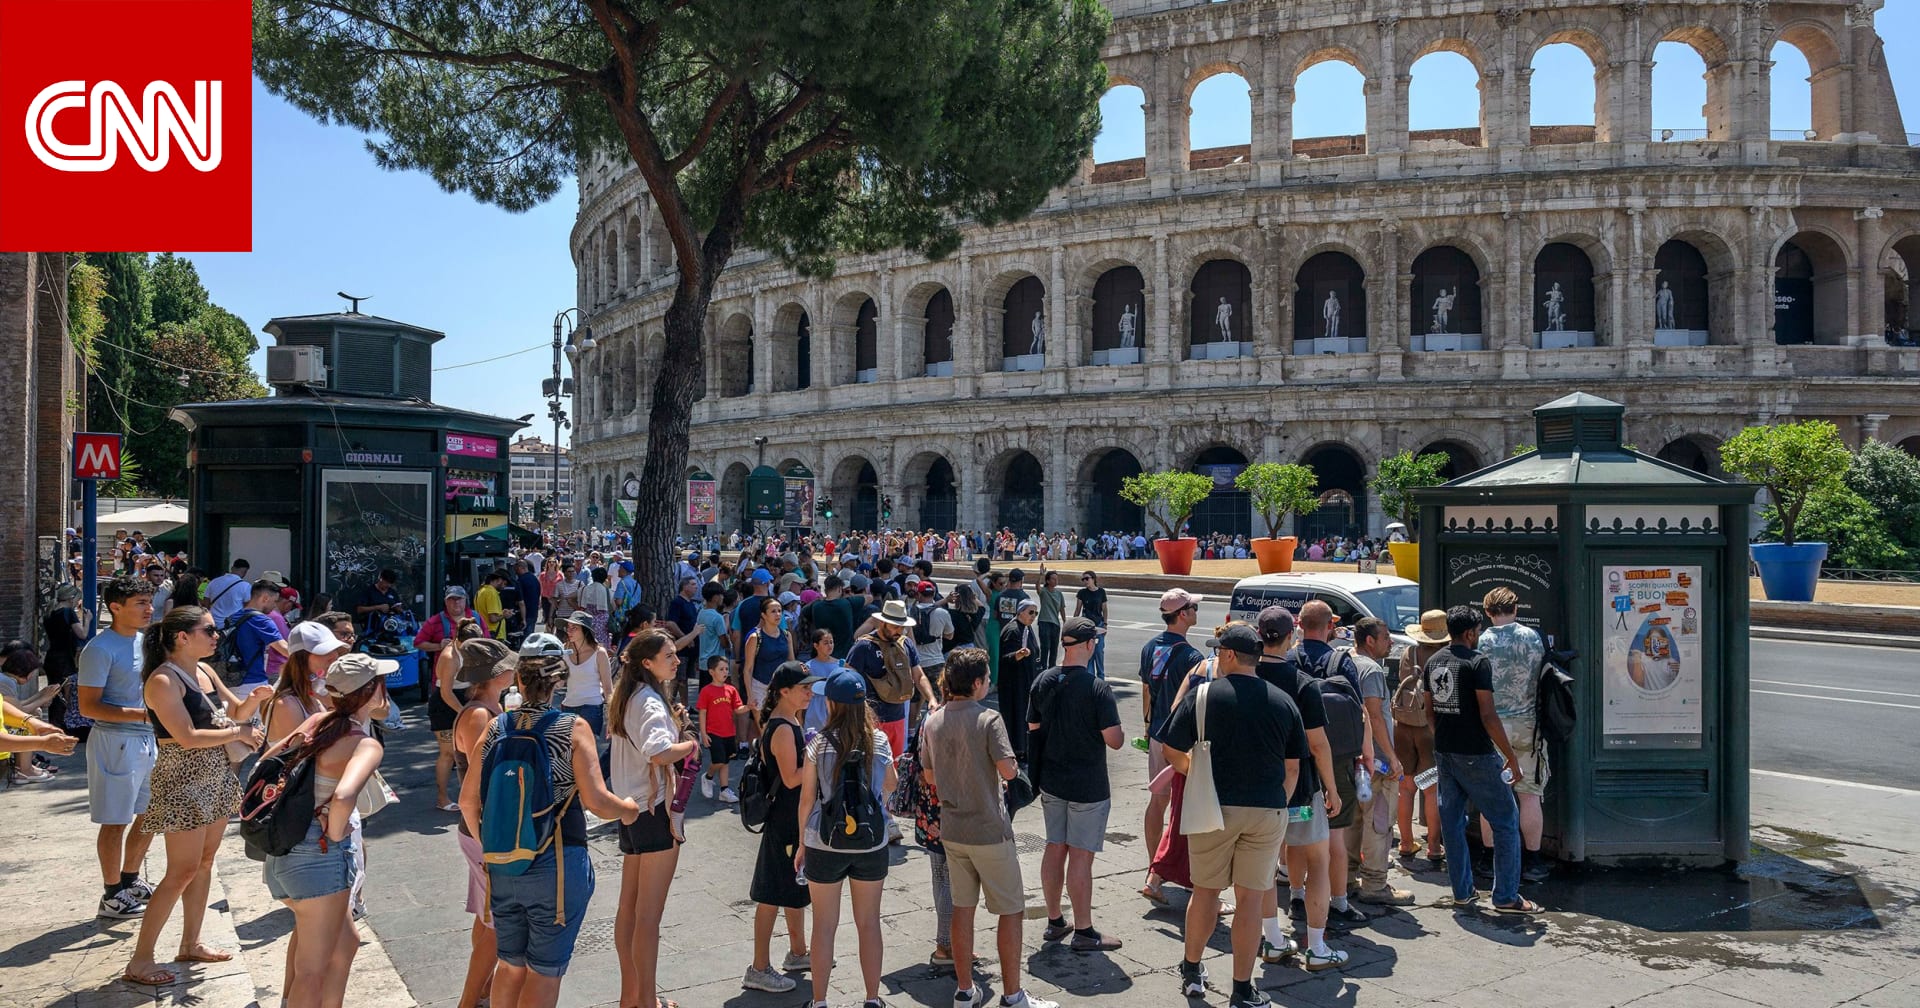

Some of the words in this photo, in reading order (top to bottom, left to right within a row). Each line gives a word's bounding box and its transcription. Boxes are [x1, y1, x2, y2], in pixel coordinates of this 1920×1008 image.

[79, 443, 116, 470] M
[345, 452, 402, 464] GIORNALI
[473, 495, 495, 508] ATM
[472, 518, 489, 527] ATM
[1637, 590, 1667, 600] BUON
[1246, 596, 1272, 607] Gruppo
